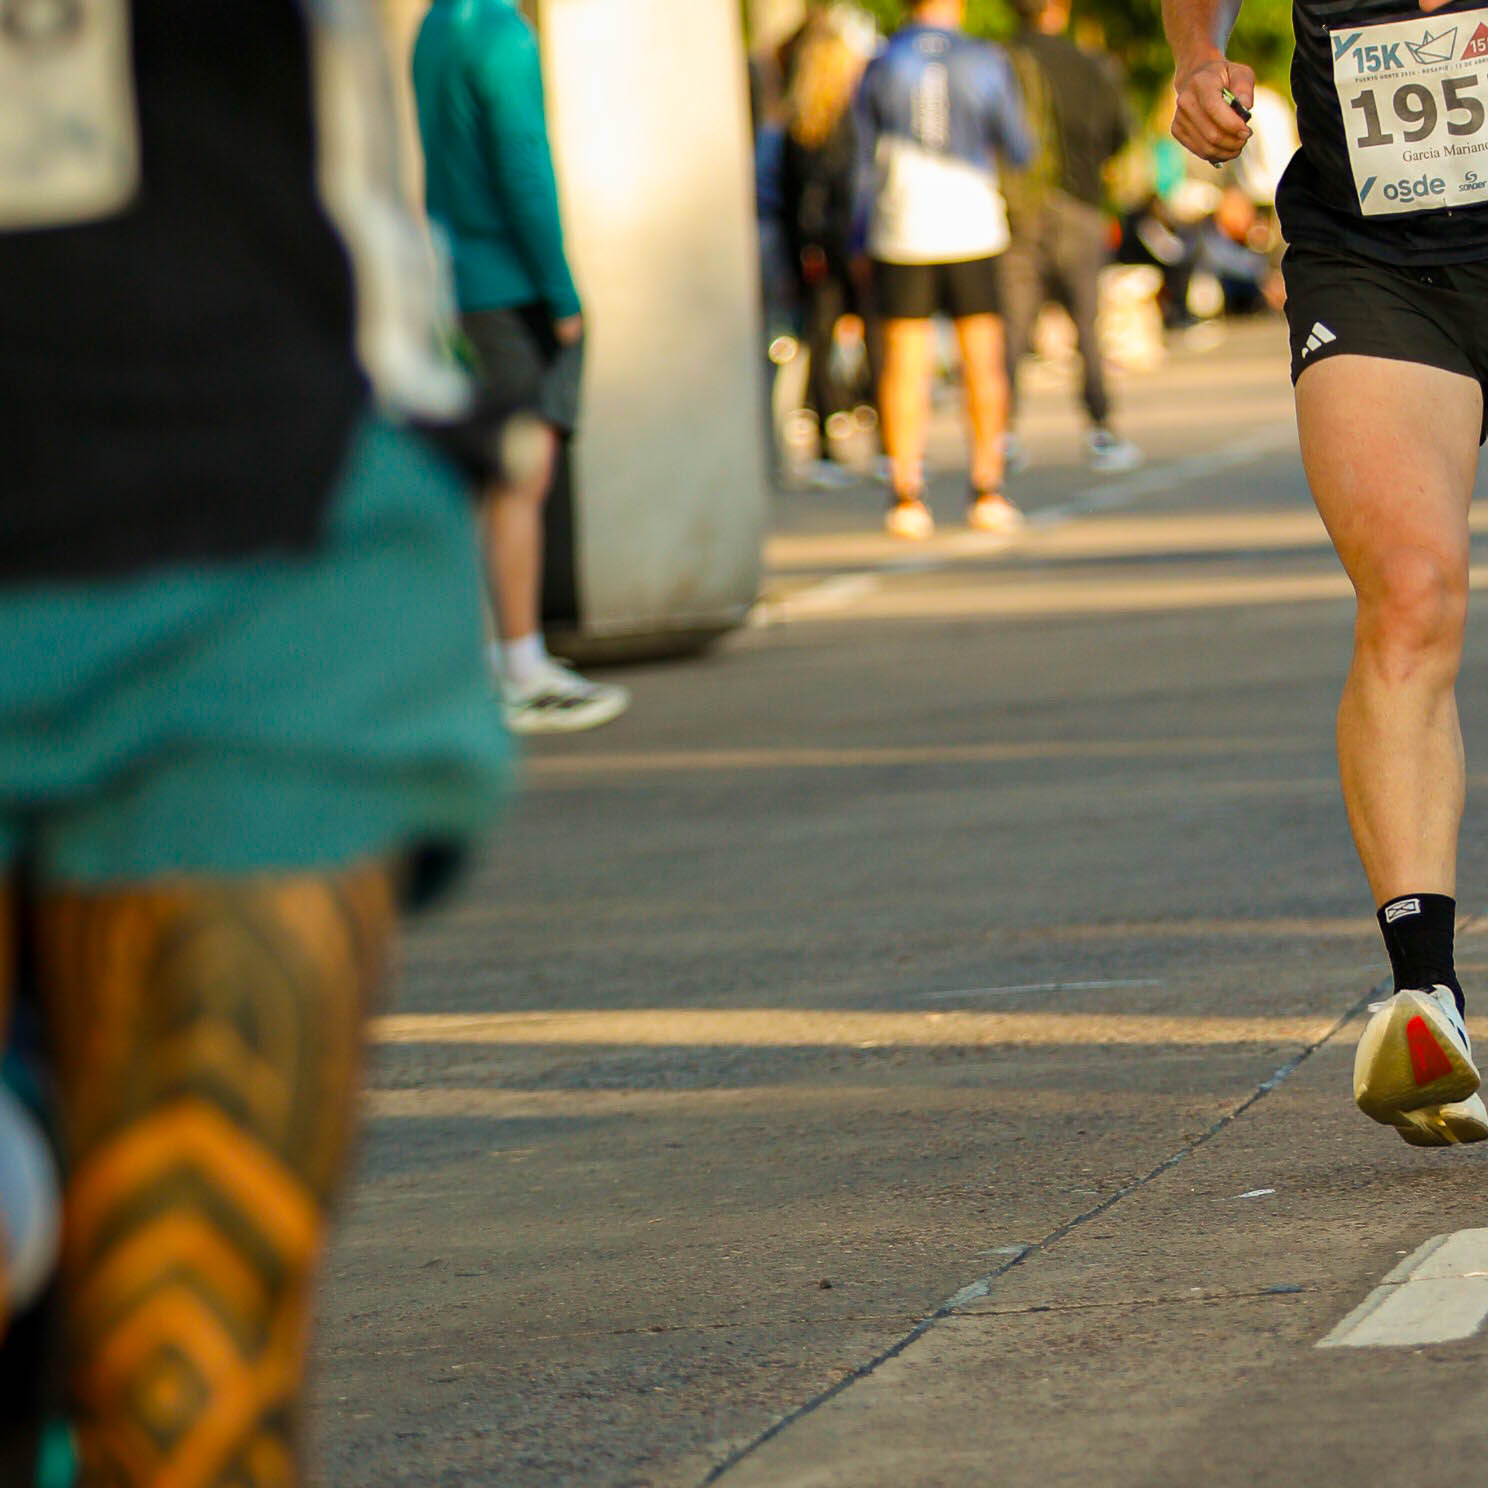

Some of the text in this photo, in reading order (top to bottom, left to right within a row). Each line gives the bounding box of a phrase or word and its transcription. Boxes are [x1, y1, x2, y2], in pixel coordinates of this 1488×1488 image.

[1352, 42, 1404, 73] 15K
[1402, 147, 1441, 162] Garcia
[1383, 174, 1446, 202] osde
